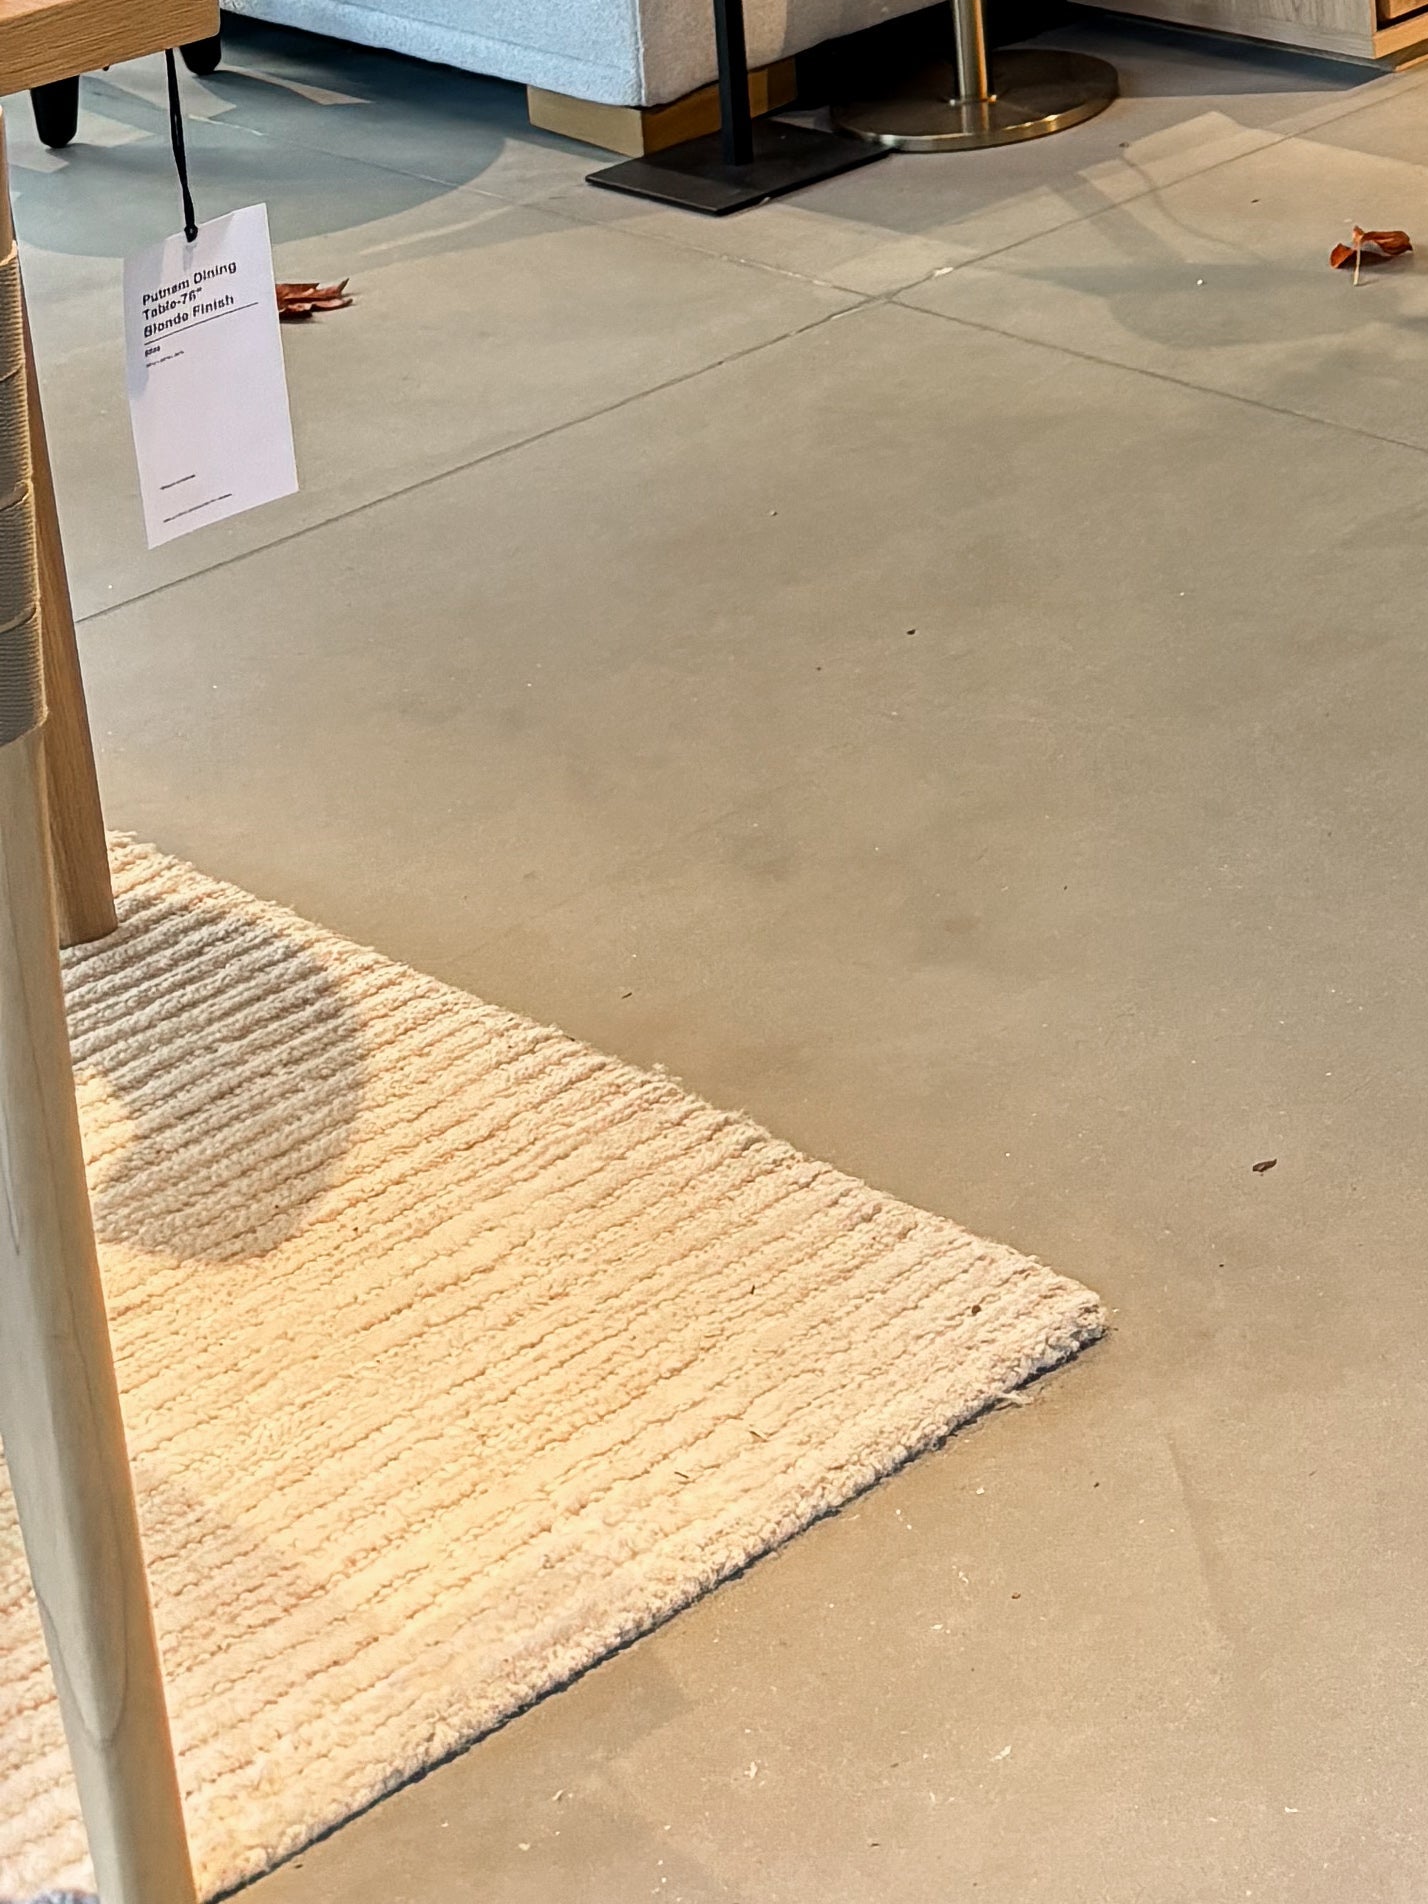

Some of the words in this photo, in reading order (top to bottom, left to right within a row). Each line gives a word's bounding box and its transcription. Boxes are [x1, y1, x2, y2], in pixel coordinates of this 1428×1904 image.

[142, 279, 190, 306] Putnam
[193, 261, 237, 285] Dining
[143, 312, 189, 338] Blonde
[192, 294, 235, 317] Finish
